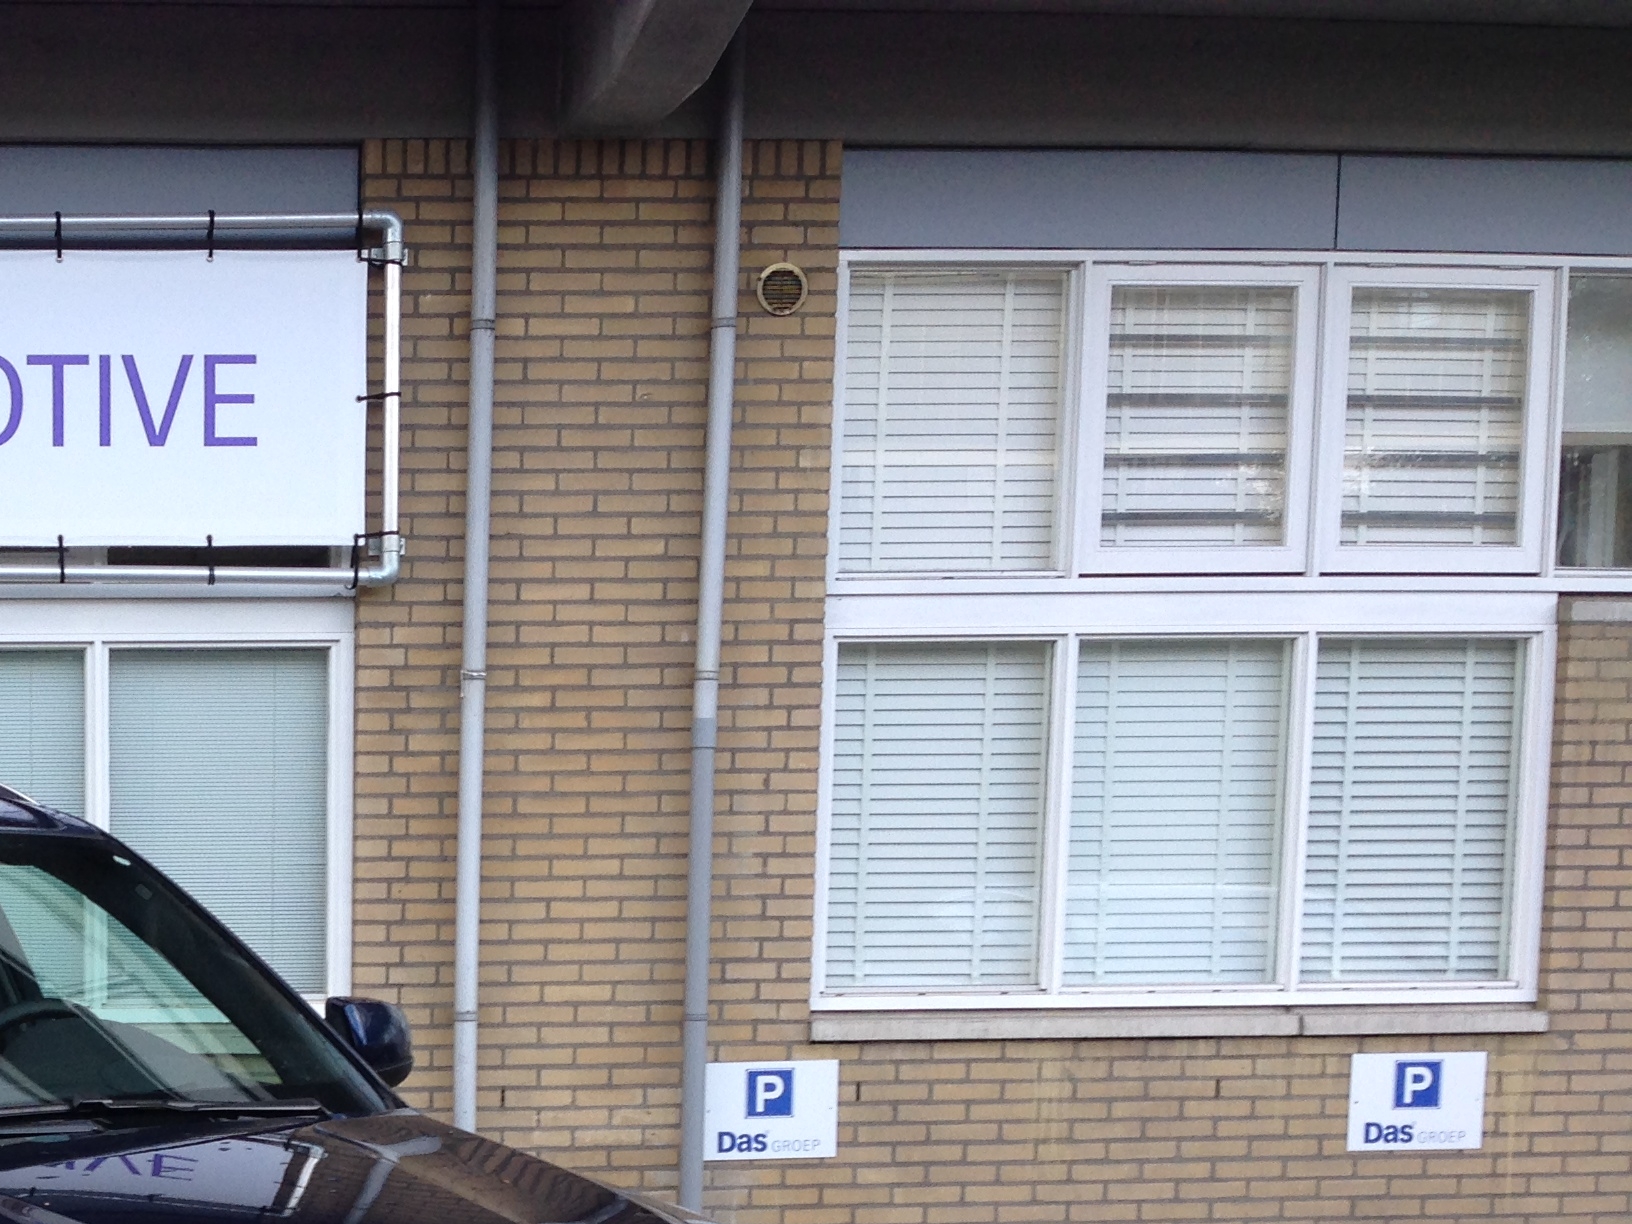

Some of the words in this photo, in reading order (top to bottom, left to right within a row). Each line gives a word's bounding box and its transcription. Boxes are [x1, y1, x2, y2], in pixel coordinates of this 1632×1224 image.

[755, 1075, 785, 1113] P
[1403, 1066, 1434, 1104] P
[716, 1131, 768, 1154] Das
[771, 1139, 821, 1153] GROEP
[1363, 1121, 1414, 1144] Das
[1418, 1130, 1467, 1144] GROEP
